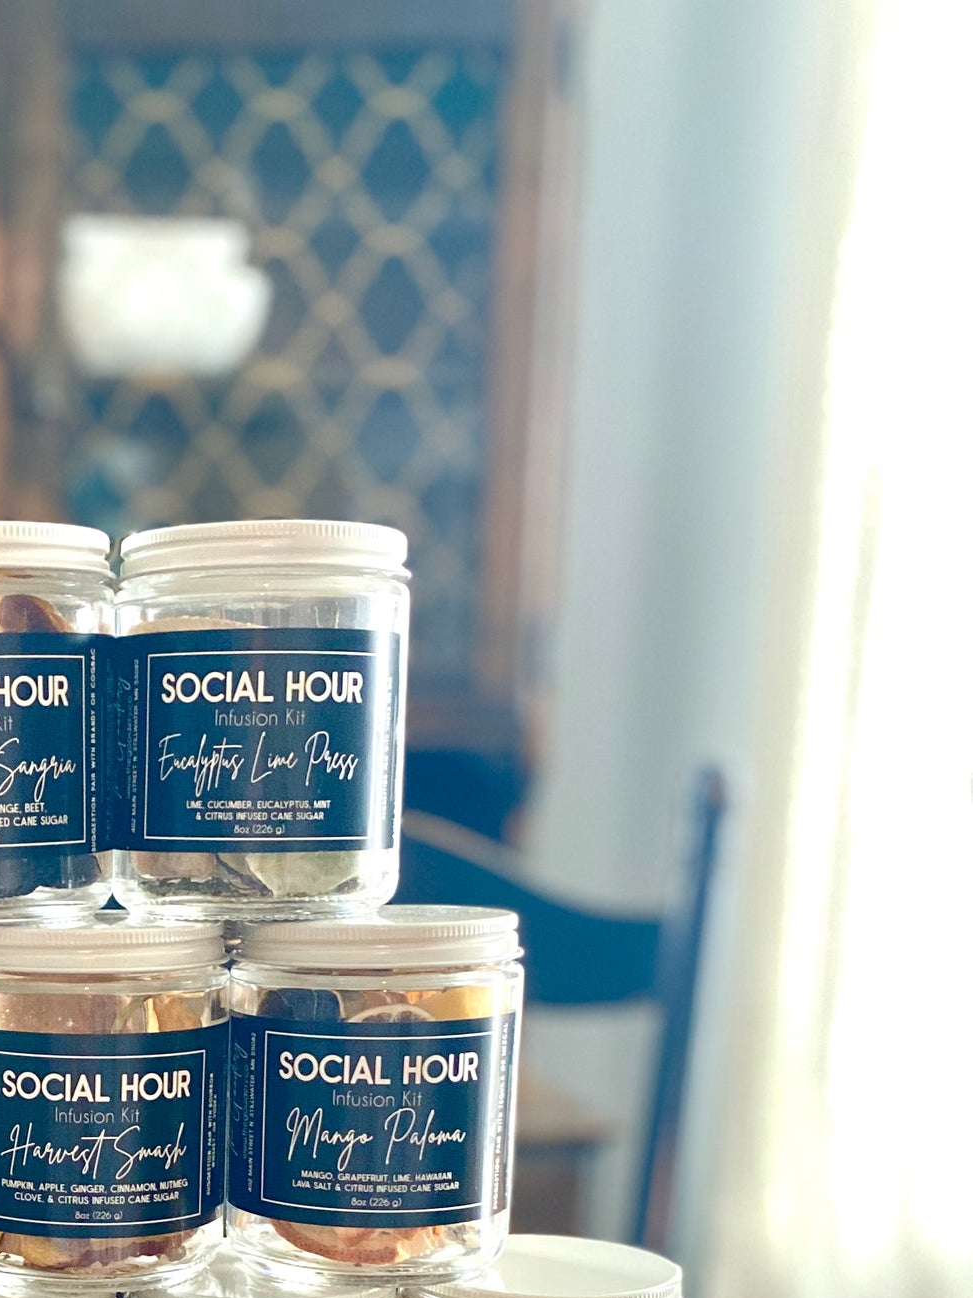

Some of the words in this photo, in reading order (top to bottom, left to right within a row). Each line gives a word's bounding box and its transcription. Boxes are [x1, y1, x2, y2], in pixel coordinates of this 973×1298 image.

[161, 670, 274, 704] SOCIAL
[286, 671, 364, 704] HOUR
[215, 709, 278, 727] Infusion
[286, 708, 306, 726] Kit
[158, 733, 245, 797] Eucalyptus
[251, 731, 298, 783] Lime
[305, 730, 359, 787] Press
[279, 1051, 391, 1085] SOCIAL
[403, 1051, 479, 1085] HOUR
[2, 1069, 110, 1102] SOCIAL
[121, 1069, 191, 1101] HOUR
[332, 1090, 395, 1107] Infusion
[402, 1091, 422, 1107] Kit
[55, 1107, 114, 1124] Infusion
[121, 1107, 140, 1123] Kit
[1, 1122, 118, 1179] Harvest
[113, 1122, 187, 1180] Smash
[286, 1107, 373, 1171] Mango
[384, 1107, 466, 1165] Paloma
